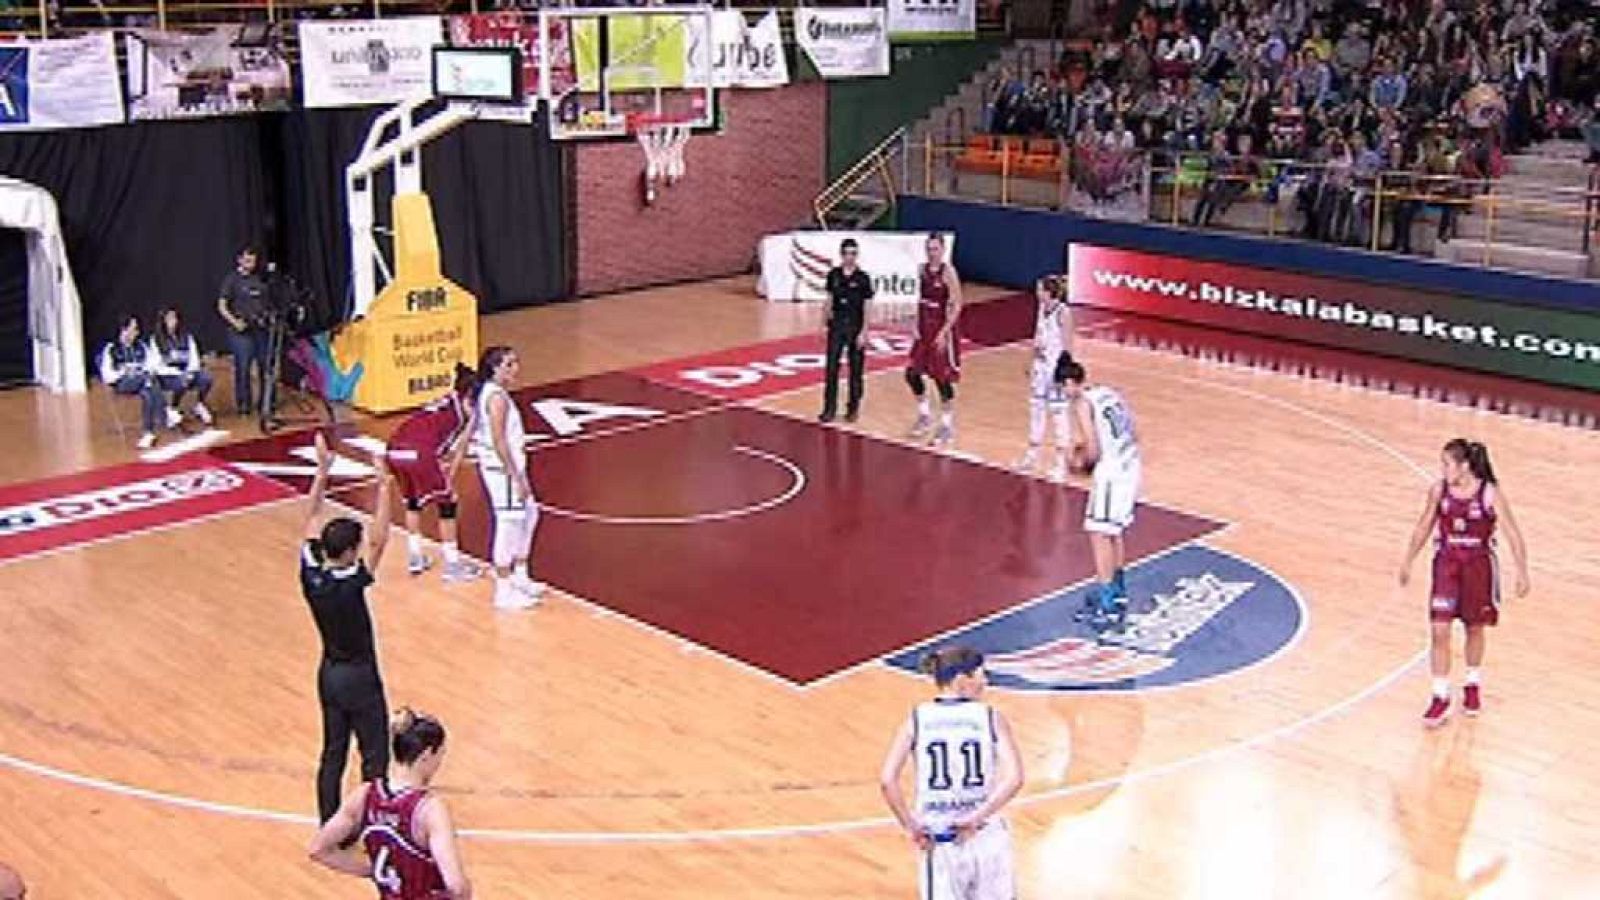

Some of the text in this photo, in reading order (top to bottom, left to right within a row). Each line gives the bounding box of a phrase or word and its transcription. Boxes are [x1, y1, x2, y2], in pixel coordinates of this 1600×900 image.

[406, 286, 447, 312] FIBA
[393, 326, 463, 351] Basketball
[392, 346, 465, 369] World Cup
[926, 738, 984, 790] 11
[374, 846, 401, 893] 4
